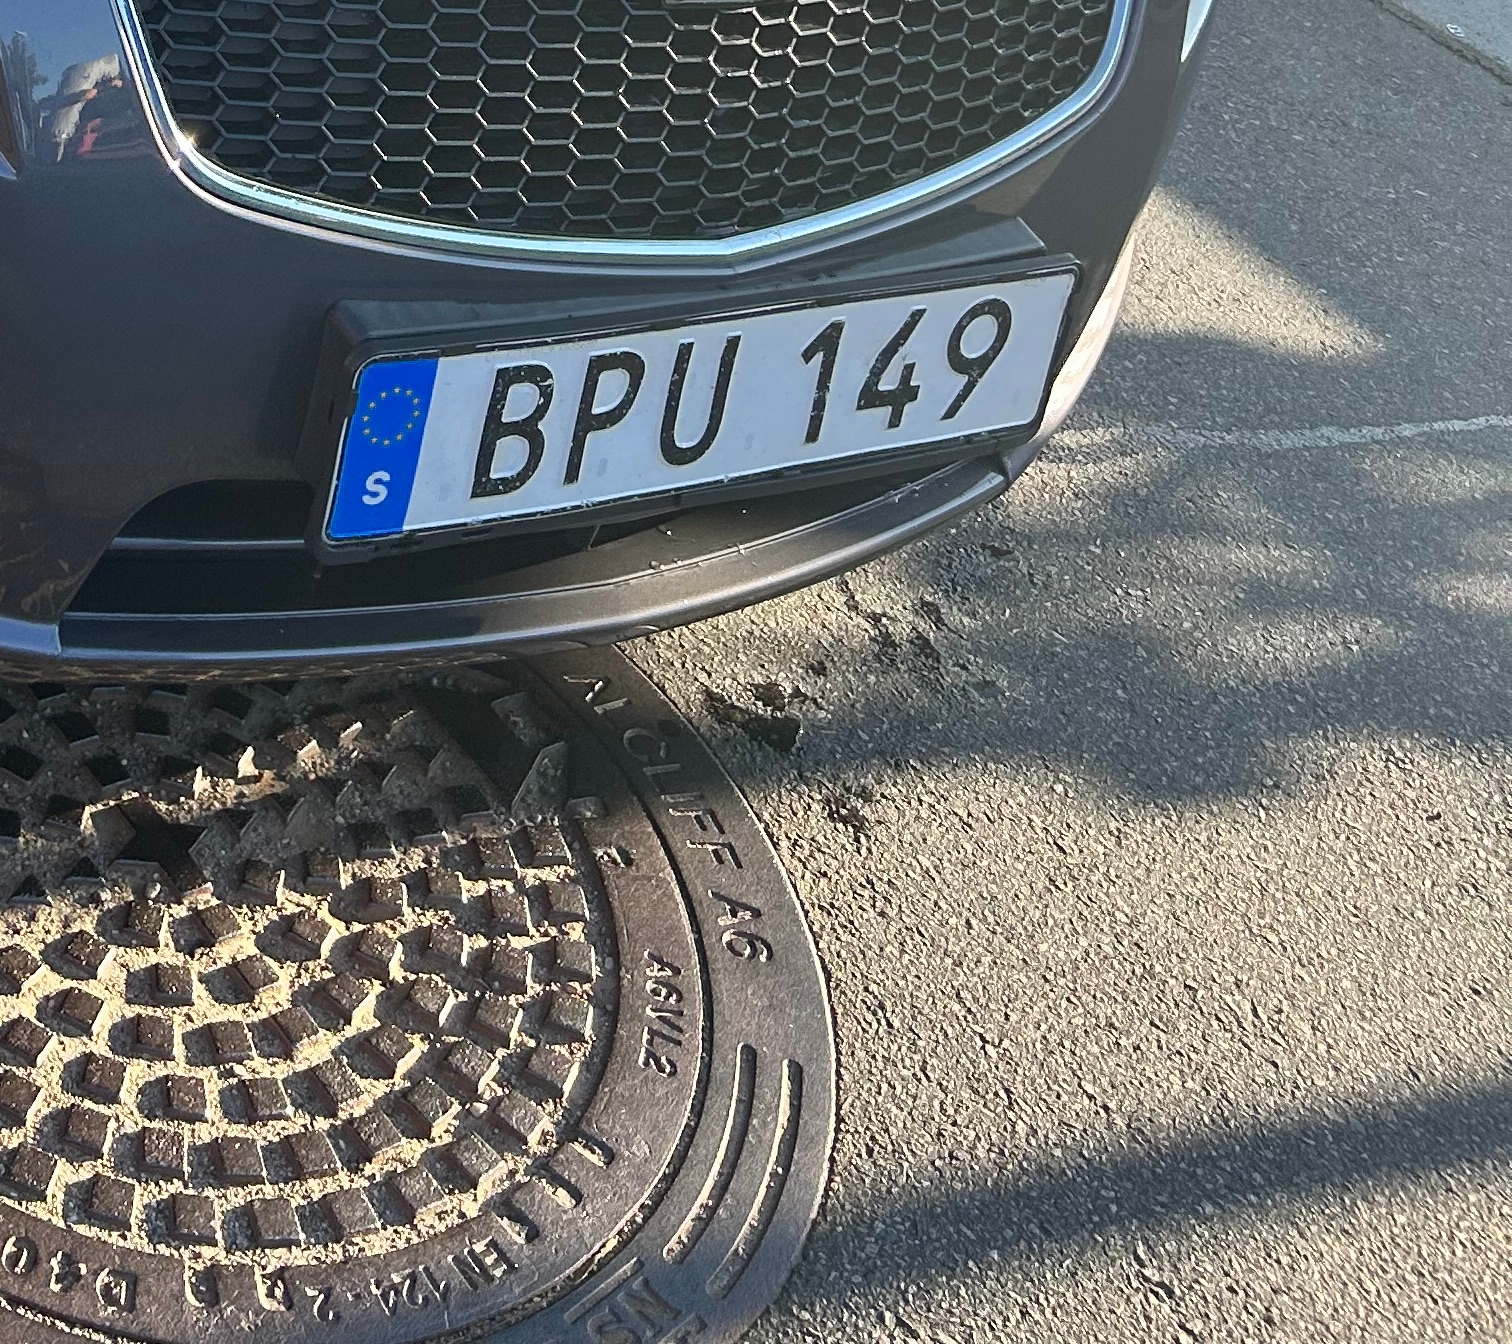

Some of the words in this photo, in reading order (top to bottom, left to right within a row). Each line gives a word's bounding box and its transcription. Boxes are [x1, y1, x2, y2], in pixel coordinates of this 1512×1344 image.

[361, 470, 392, 506] S
[470, 331, 743, 500] BPU
[799, 296, 1013, 446] 149
[707, 889, 775, 964] A6
